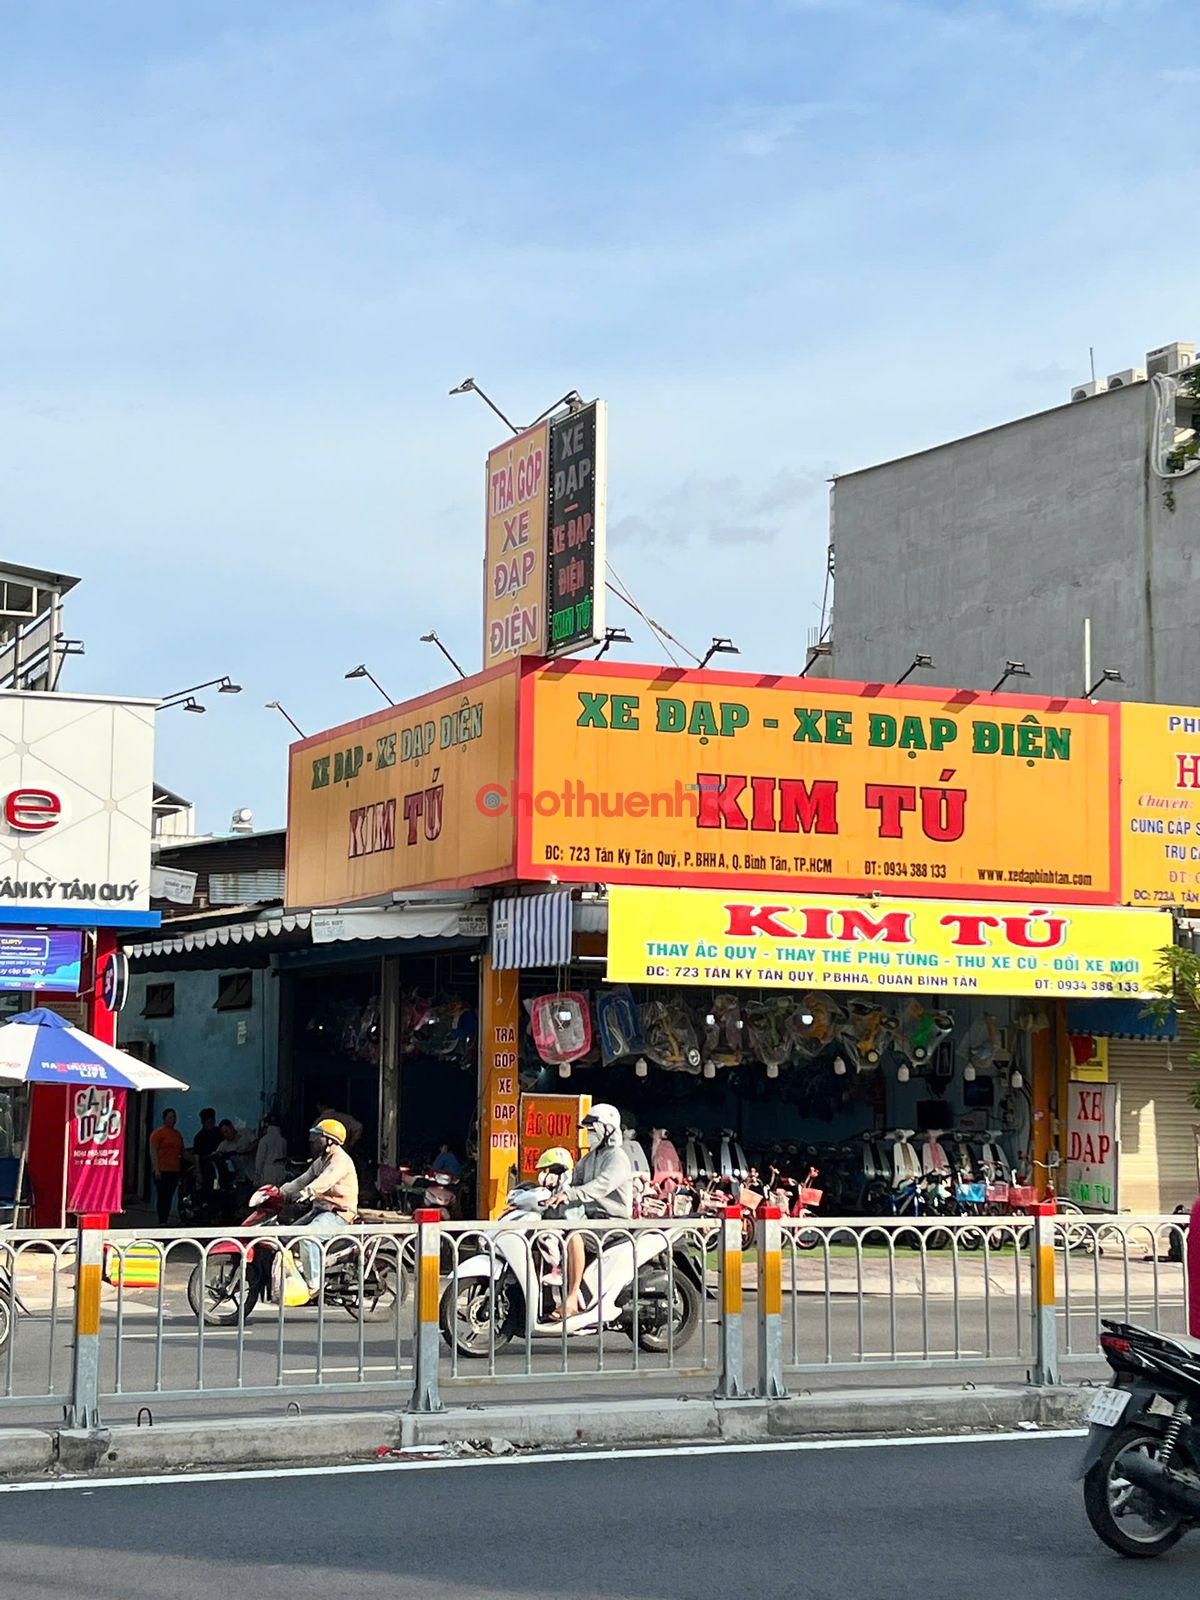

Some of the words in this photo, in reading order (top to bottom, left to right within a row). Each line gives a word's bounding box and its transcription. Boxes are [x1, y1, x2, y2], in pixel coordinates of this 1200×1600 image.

[561, 421, 584, 459] XE
[491, 449, 513, 513] TRẢ
[517, 442, 542, 501] GÓP
[554, 458, 591, 500] ĐẠP
[503, 511, 529, 553] XE
[552, 519, 569, 555] XE
[568, 512, 591, 550] ĐẠP
[494, 551, 535, 597] ĐẠP
[559, 557, 585, 597] ĐIỆN
[490, 605, 537, 655] ĐIỆN
[577, 692, 639, 731] XE
[656, 697, 749, 745] ĐẠP
[793, 707, 852, 745] XE
[868, 713, 957, 759] ĐẠP
[972, 714, 1071, 768] ĐIỆN
[1169, 716, 1200, 733] PH
[311, 756, 330, 790] XE
[376, 733, 397, 770] XE
[348, 799, 397, 859] KIM
[404, 767, 444, 846] TÚ
[696, 773, 839, 835] KIM
[864, 768, 967, 842] TÚ
[1131, 818, 1163, 834] CUNG
[545, 845, 564, 860] ĐC:
[569, 846, 590, 861] 723
[635, 849, 653, 864] Tân
[793, 857, 832, 873] TP.HCM
[883, 861, 907, 877] 0934
[910, 863, 927, 877] 388
[930, 864, 946, 879] 133
[0, 876, 27, 898] ÂN
[58, 878, 96, 900] TÂN
[100, 880, 139, 901] QUÝ
[977, 868, 1092, 886] www.xedapbinhtan.com
[1153, 891, 1175, 901] 723A
[724, 904, 911, 943] KIM
[940, 909, 1067, 948] TÚ
[646, 943, 689, 956] THAY
[724, 945, 757, 959] QUY
[776, 948, 816, 962] THAY
[822, 946, 852, 963] THẾ
[858, 951, 890, 967] PHỤ
[896, 951, 938, 966] TÙNG
[956, 955, 985, 968] THU
[992, 956, 1010, 969] XE
[1054, 954, 1079, 971] ĐỔI
[1086, 960, 1104, 972] XE
[1110, 959, 1139, 973] MỚI
[646, 966, 669, 977] ĐC:
[675, 967, 699, 977] 723
[704, 966, 731, 978] TÂN
[758, 967, 783, 980] TÂN
[1058, 980, 1087, 990] 0934
[1118, 982, 1139, 992] 133
[499, 1079, 512, 1093] XE
[1078, 1091, 1104, 1121] XE
[547, 1112, 571, 1138] QUY
